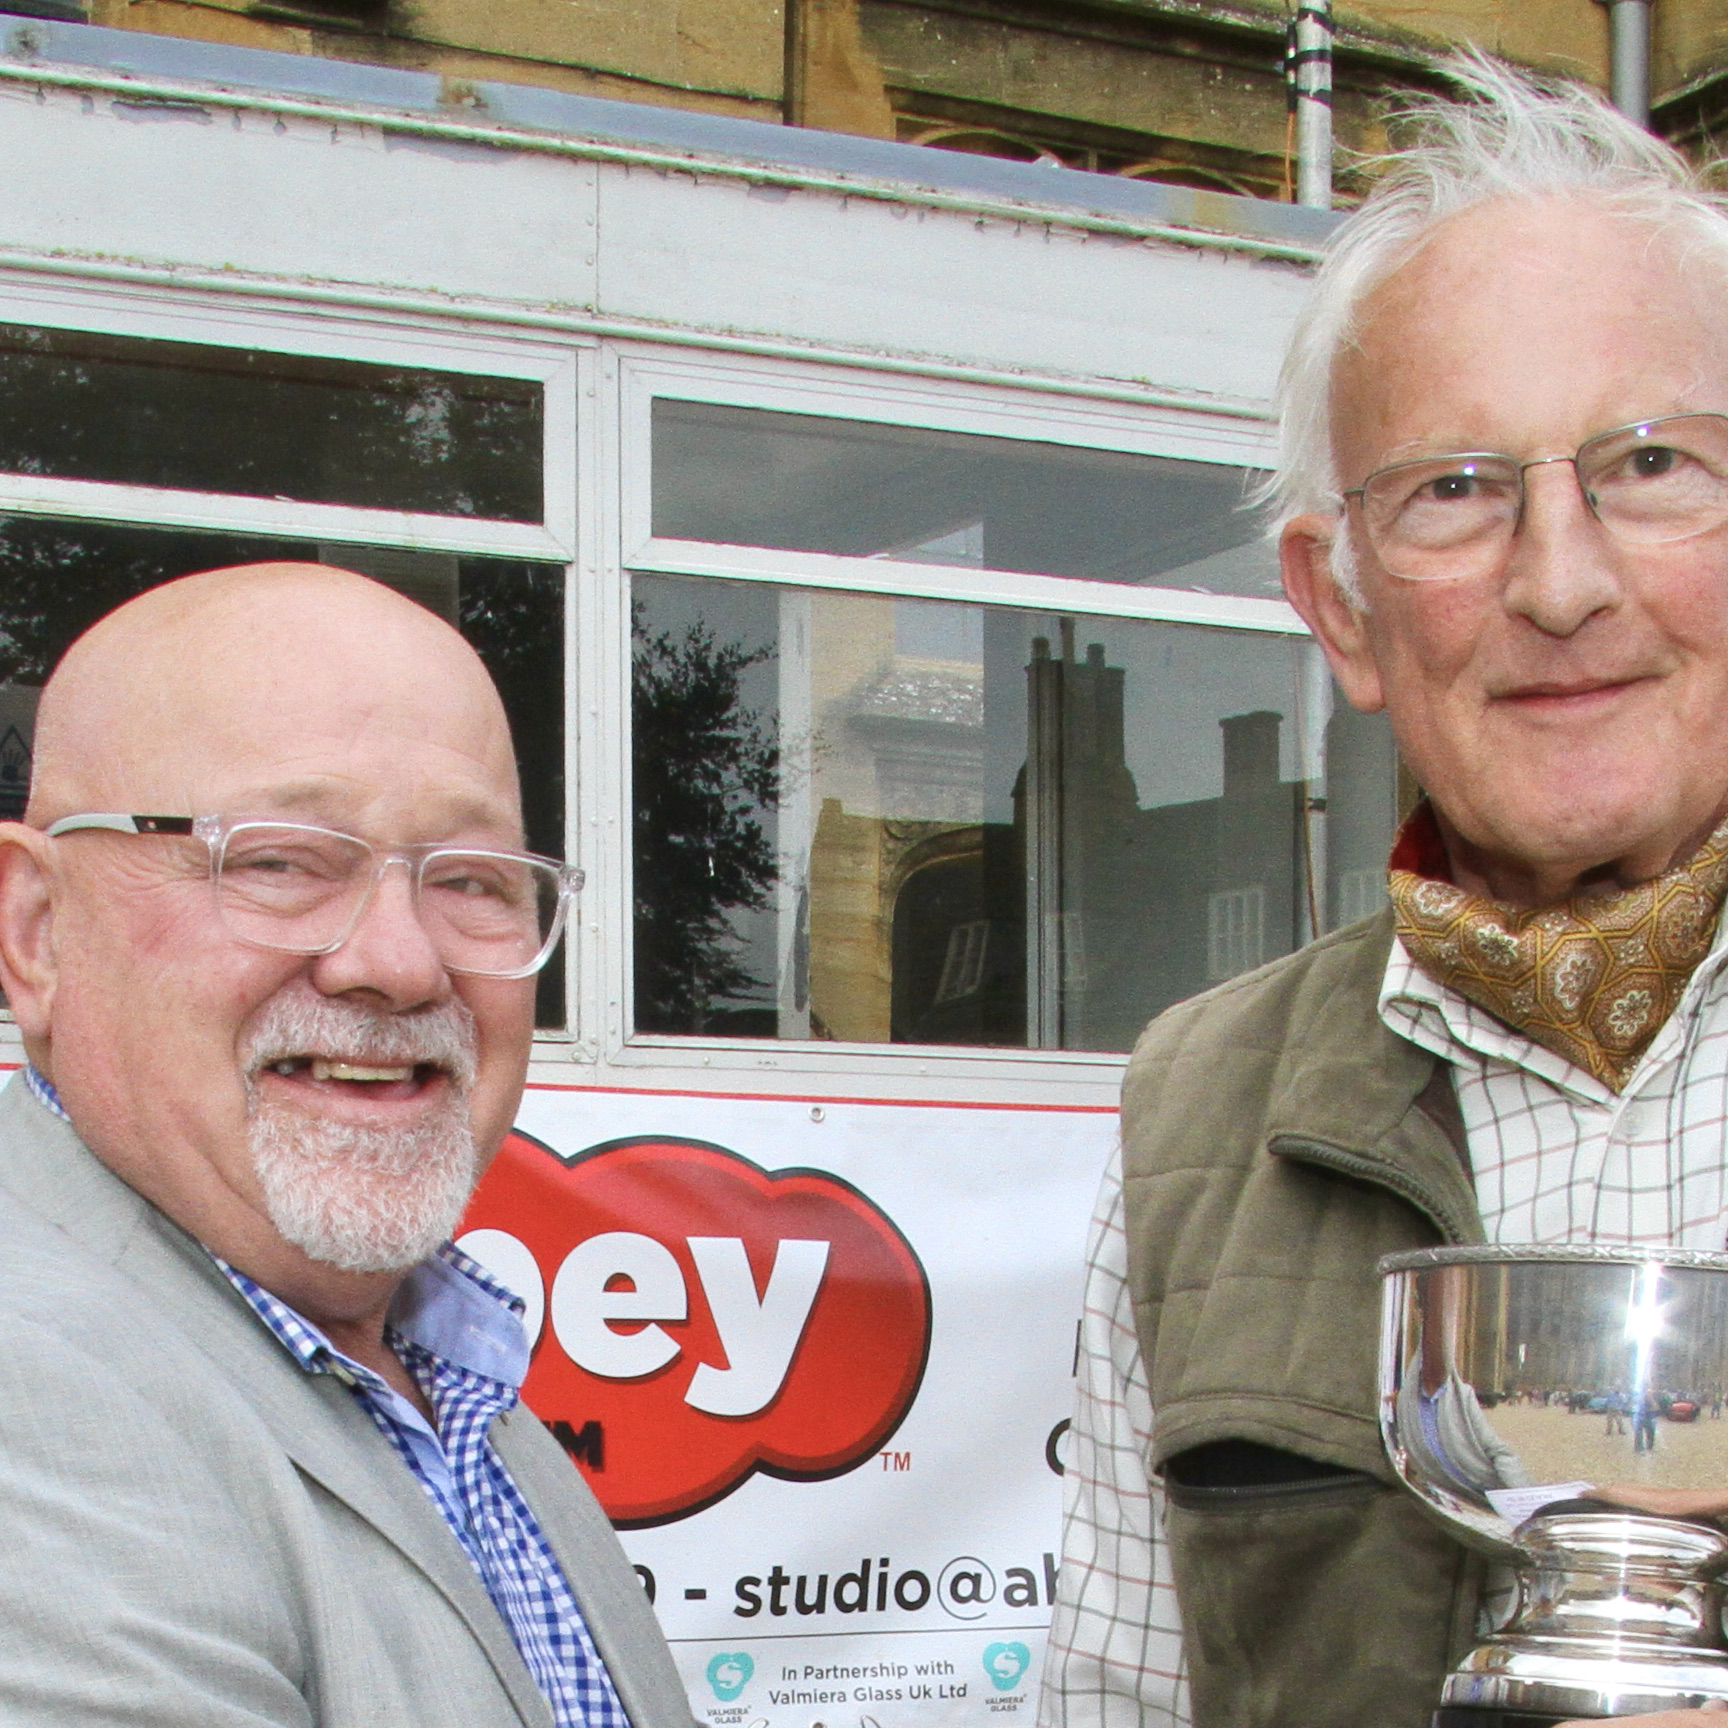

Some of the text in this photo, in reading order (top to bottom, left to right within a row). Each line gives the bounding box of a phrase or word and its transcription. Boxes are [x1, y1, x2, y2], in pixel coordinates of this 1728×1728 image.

[781, 1660, 955, 1681] In Partnership with
[768, 1682, 968, 1705] Valmiera Glass Uk Ltd
